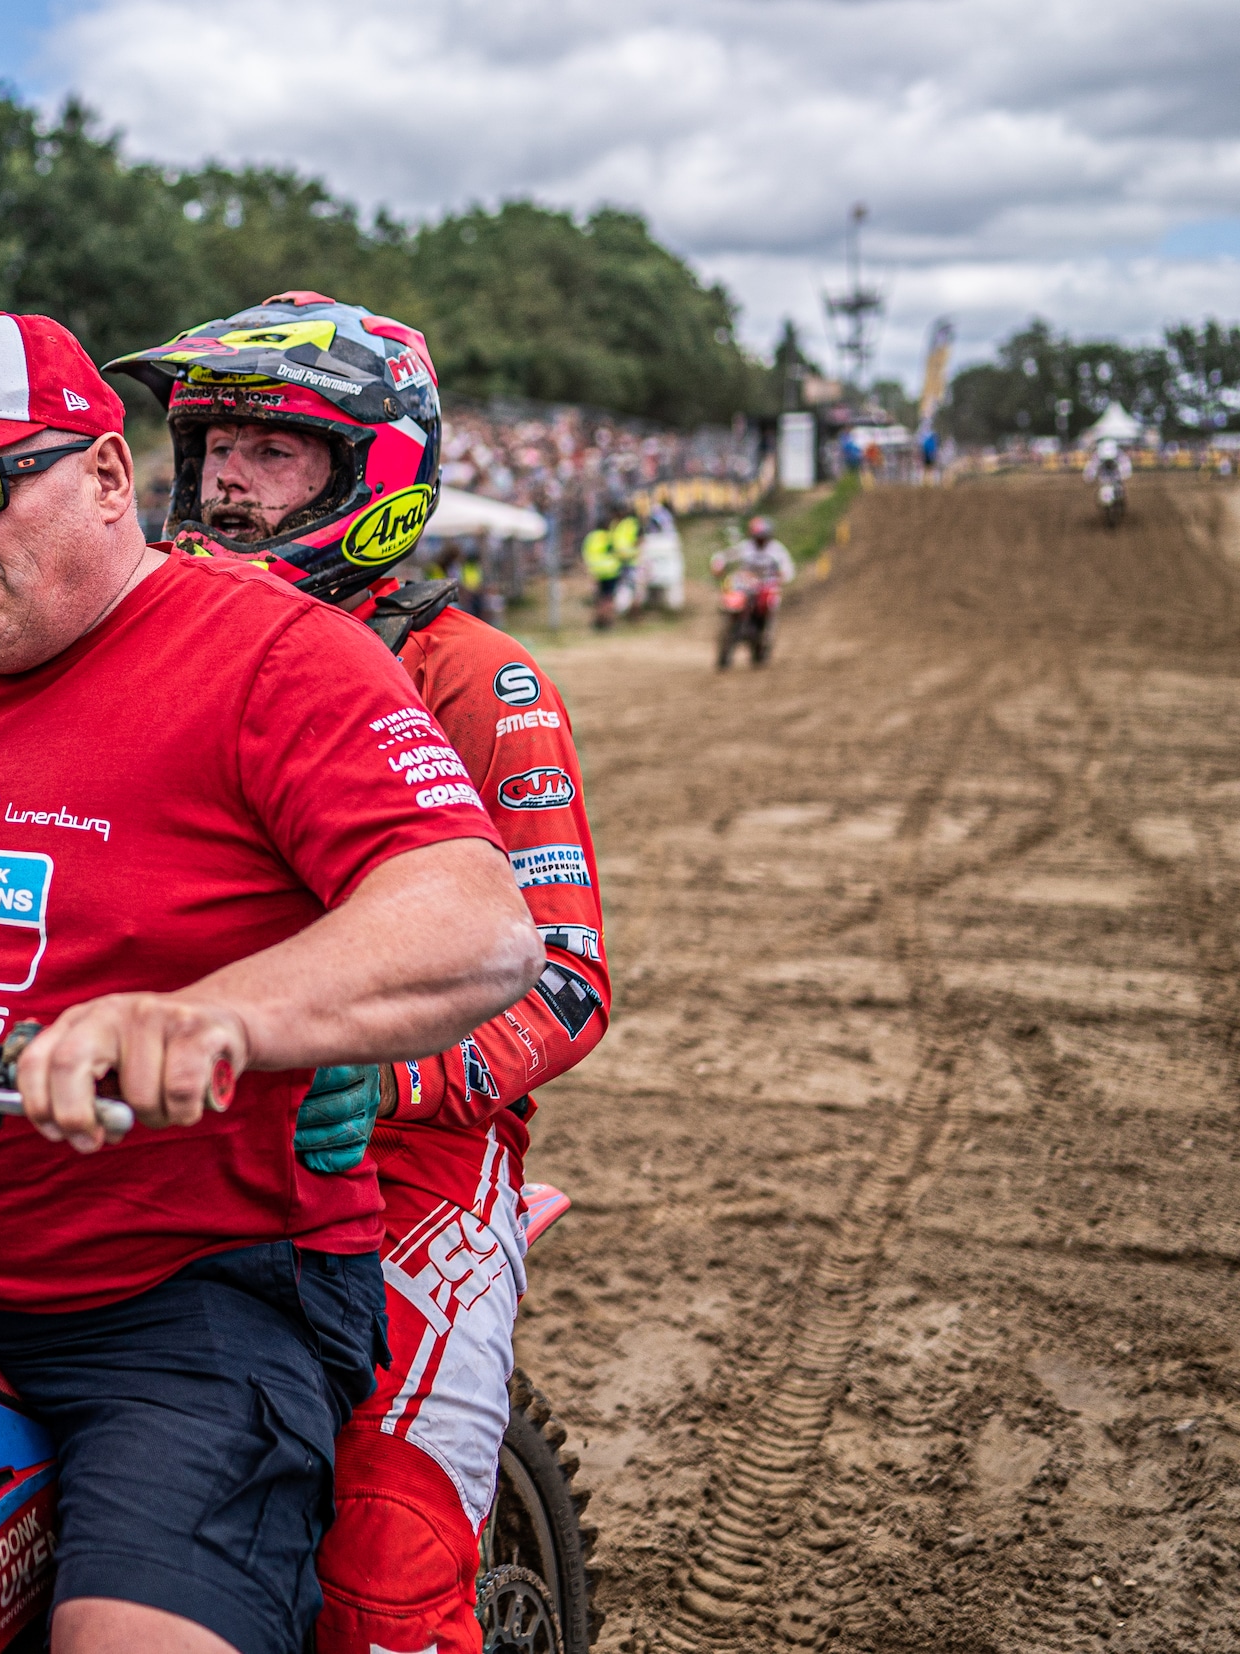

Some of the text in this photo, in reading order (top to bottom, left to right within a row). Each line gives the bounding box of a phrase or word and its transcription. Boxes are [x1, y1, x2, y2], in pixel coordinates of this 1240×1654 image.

[303, 368, 363, 396] Performance
[354, 496, 427, 554] Arai
[4, 802, 111, 842] Lunenburg
[529, 862, 581, 876] SUSPENSION
[503, 1009, 541, 1073] enburg
